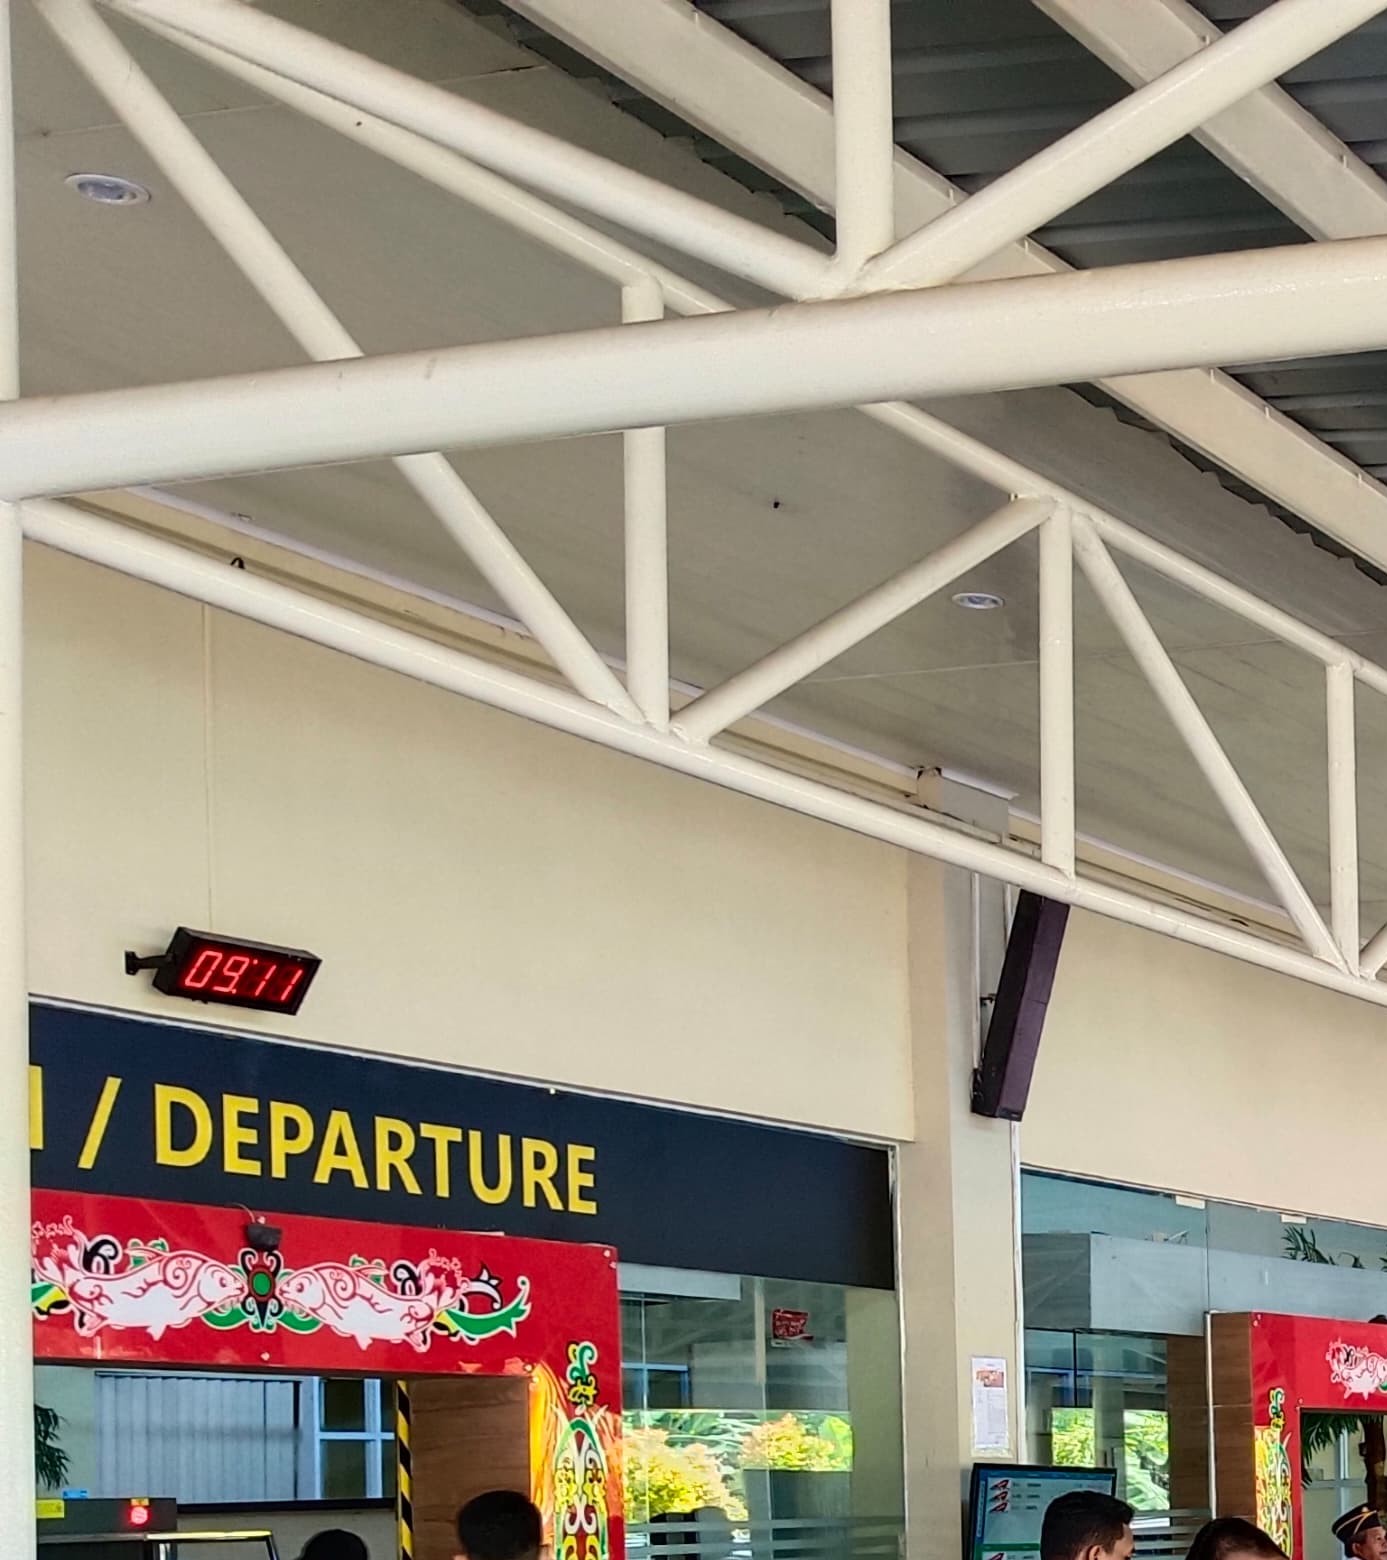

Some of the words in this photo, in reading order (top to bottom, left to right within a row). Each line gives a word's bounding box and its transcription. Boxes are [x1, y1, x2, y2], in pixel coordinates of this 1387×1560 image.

[184, 950, 303, 1001] 09:11
[78, 1076, 122, 1169] /
[154, 1083, 598, 1215] DEPARTURE
